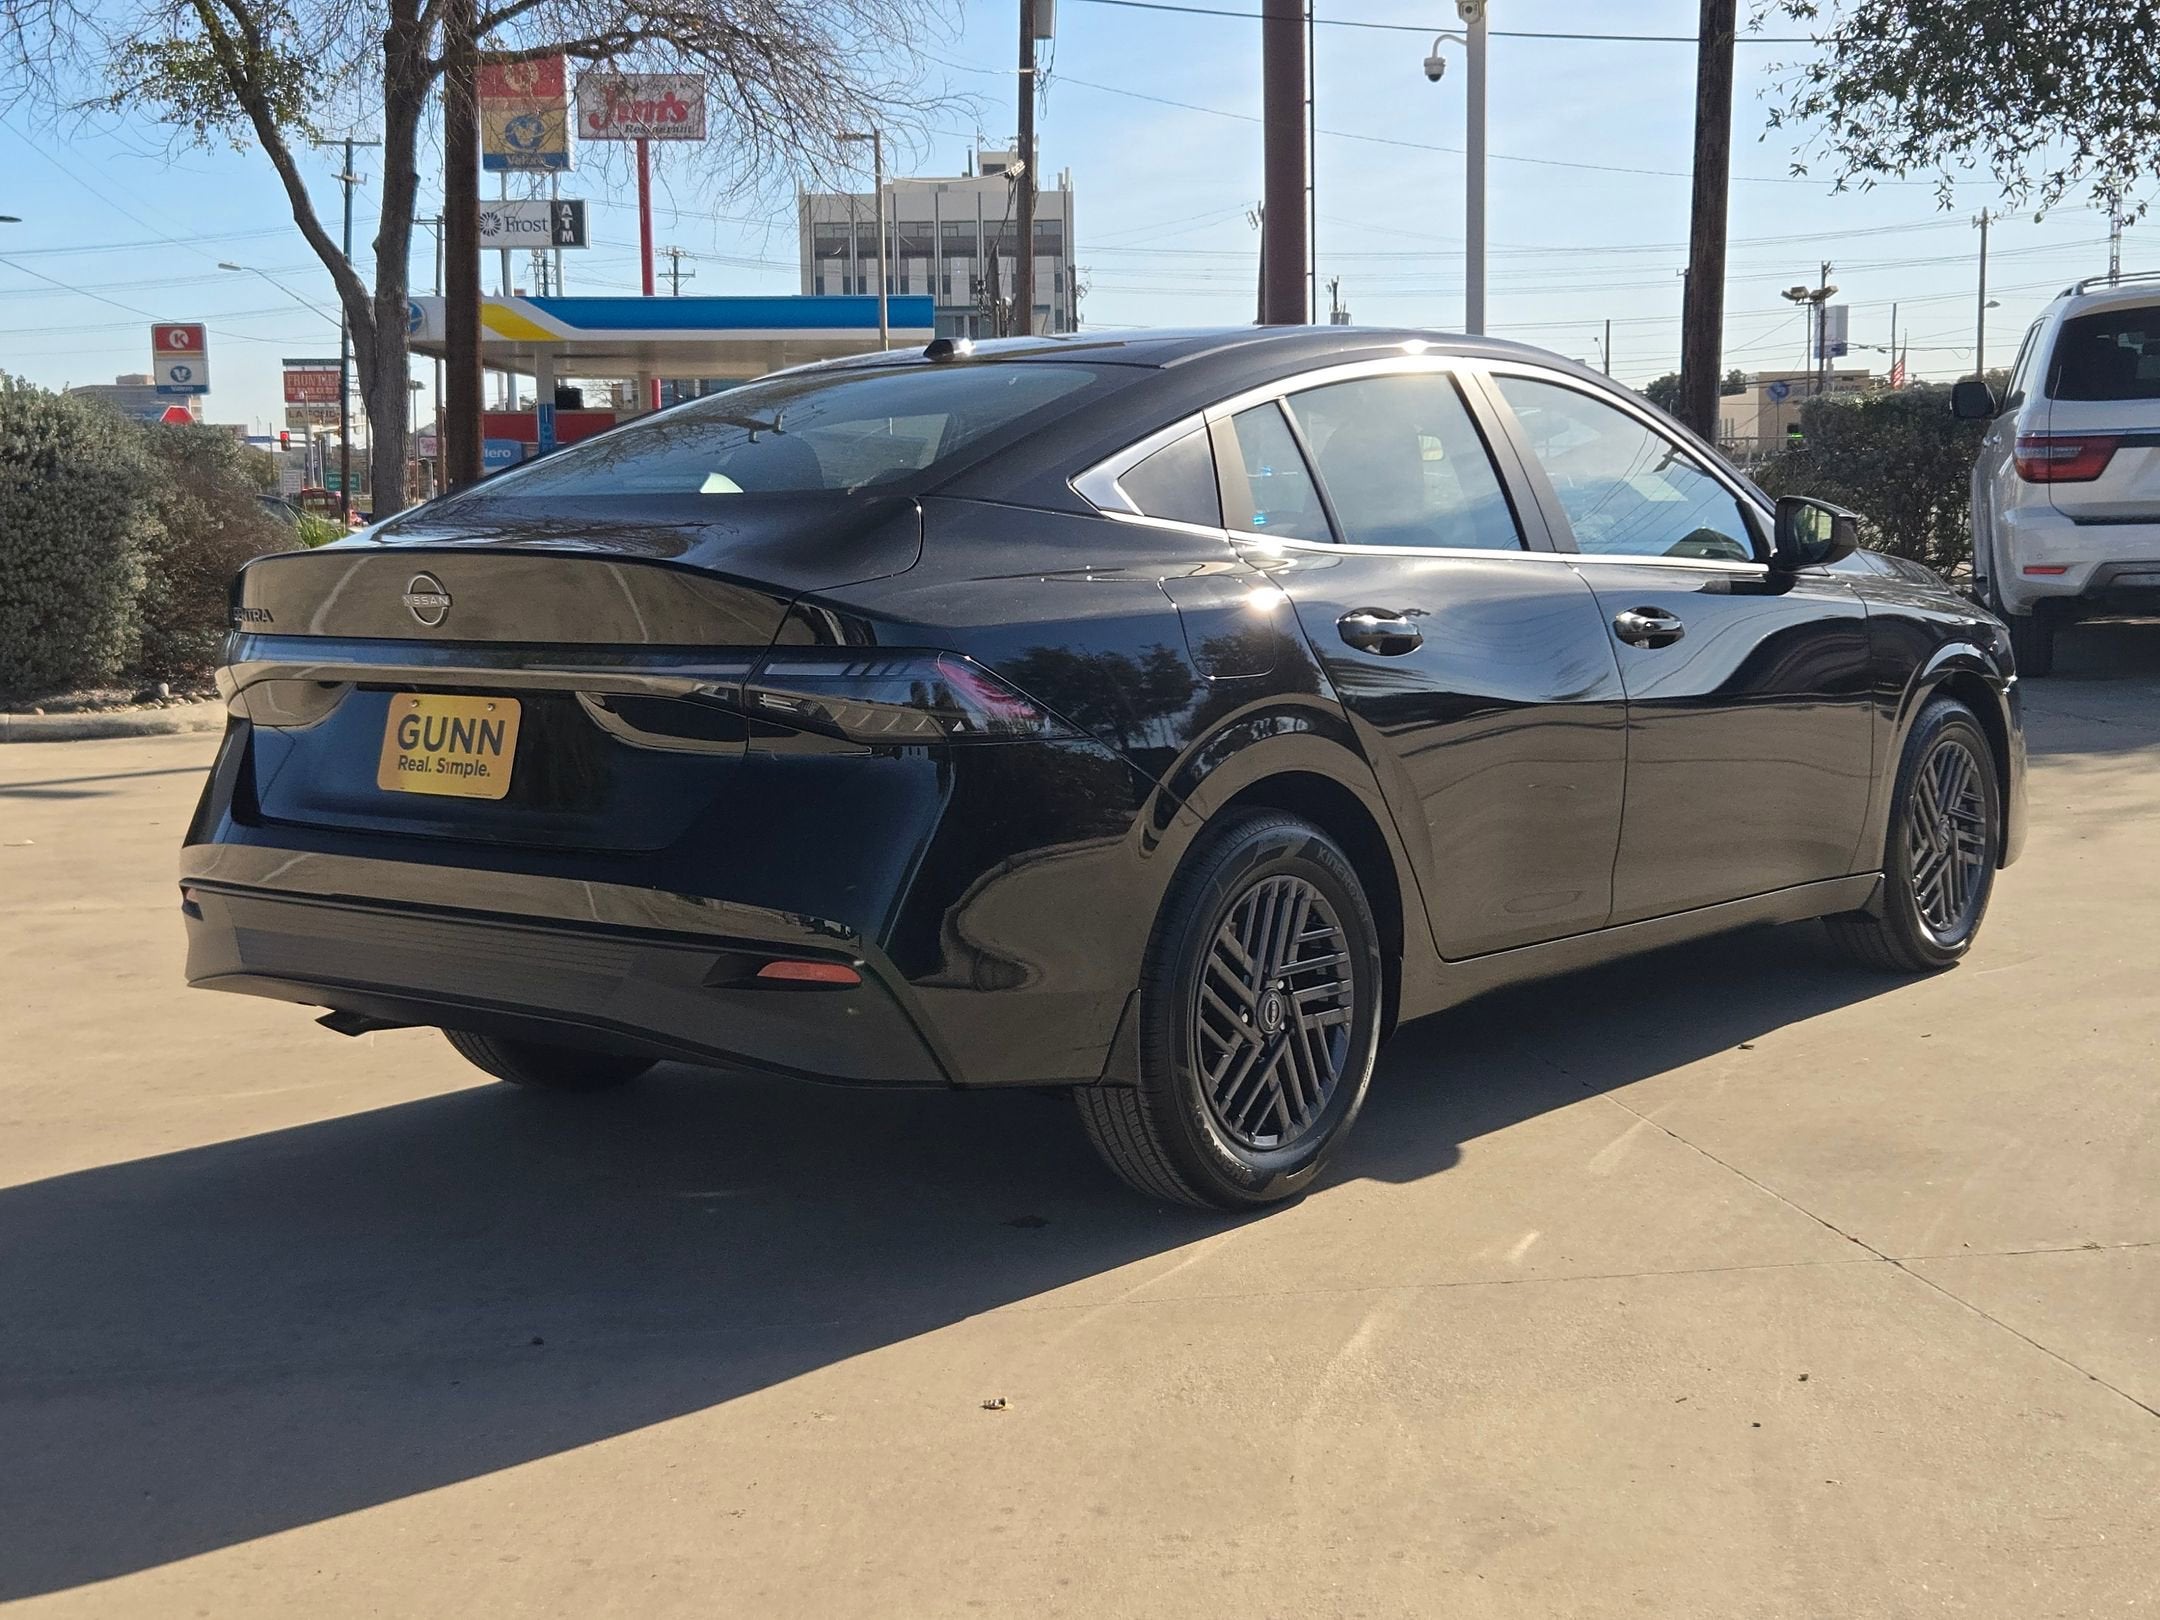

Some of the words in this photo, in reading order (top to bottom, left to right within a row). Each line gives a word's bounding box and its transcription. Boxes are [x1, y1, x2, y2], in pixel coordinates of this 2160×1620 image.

[504, 216, 548, 233] Frost
[561, 204, 574, 243] ATM
[306, 409, 339, 418] FOND
[485, 448, 511, 458] lero
[403, 596, 450, 606] NISSAN
[397, 714, 506, 756] GUNN
[398, 755, 432, 773] Real.
[436, 757, 491, 779] Simple.
